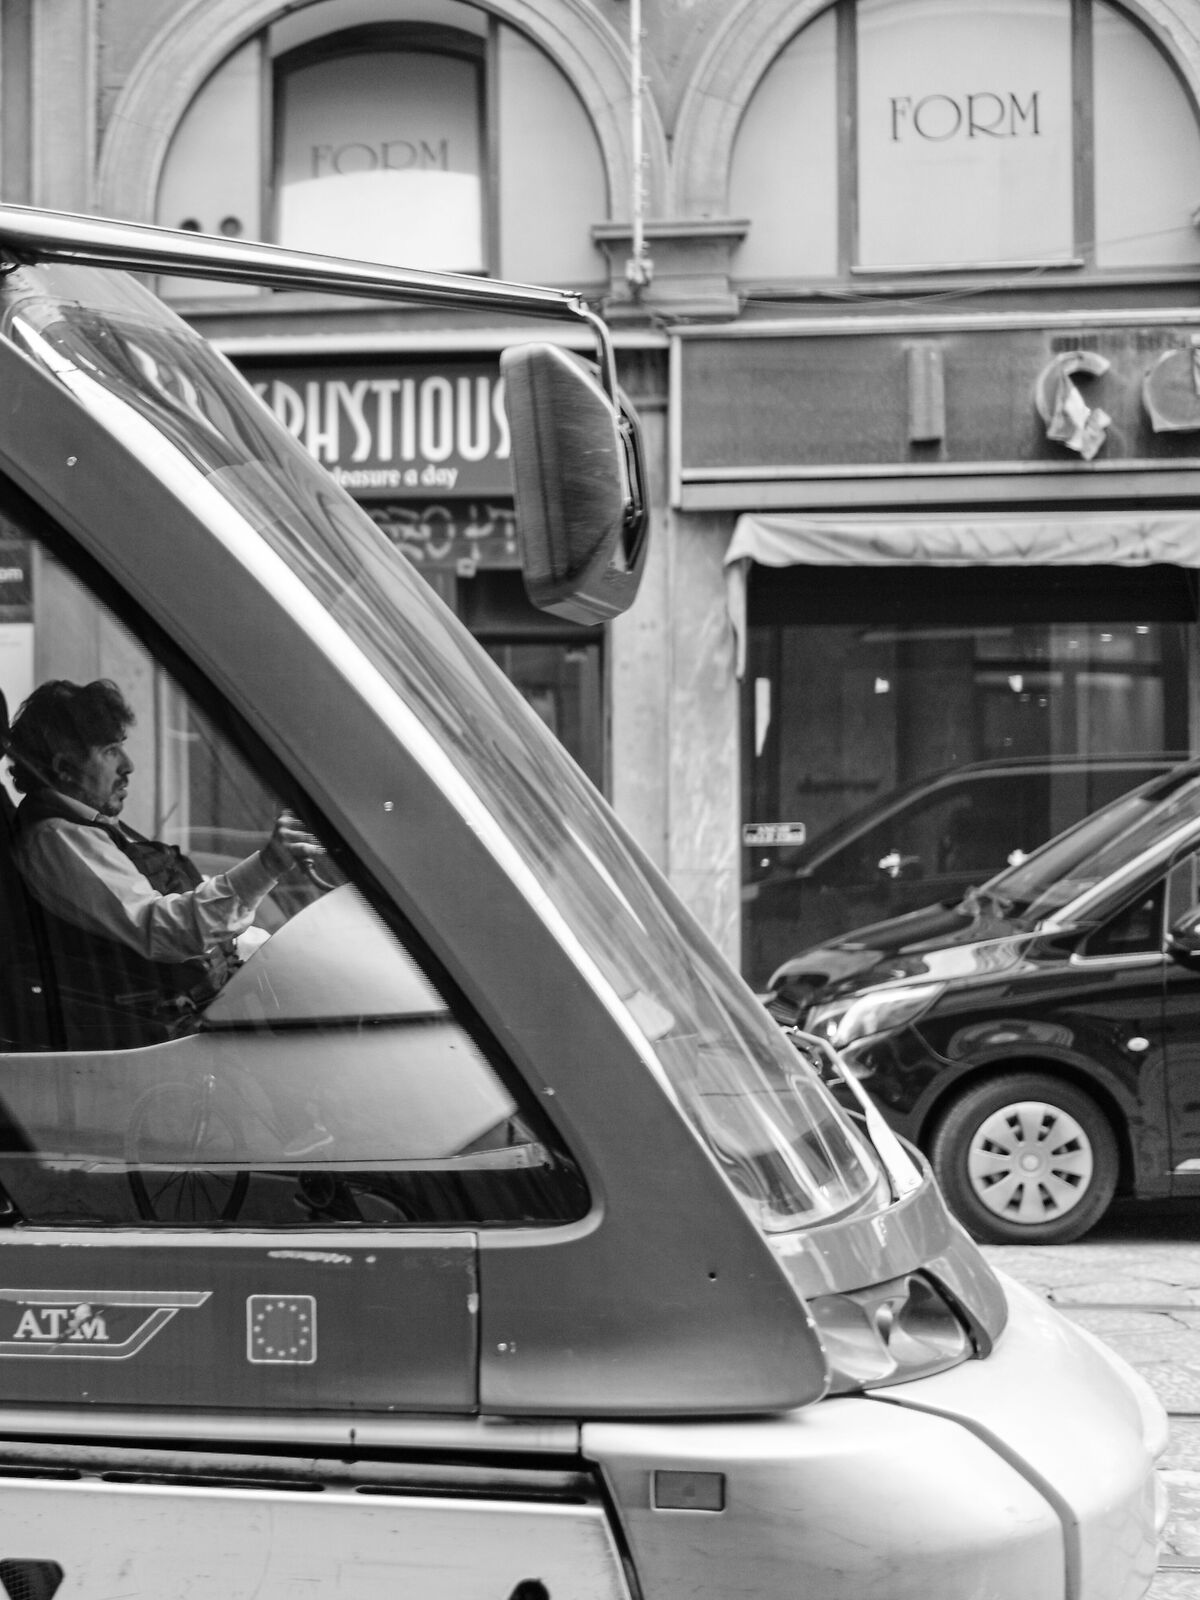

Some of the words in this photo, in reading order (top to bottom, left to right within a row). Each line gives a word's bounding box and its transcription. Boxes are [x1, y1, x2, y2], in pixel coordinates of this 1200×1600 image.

[888, 89, 1041, 143] FORM
[403, 468, 419, 487] a
[421, 464, 459, 490] day
[13, 1308, 109, 1339] ATM
